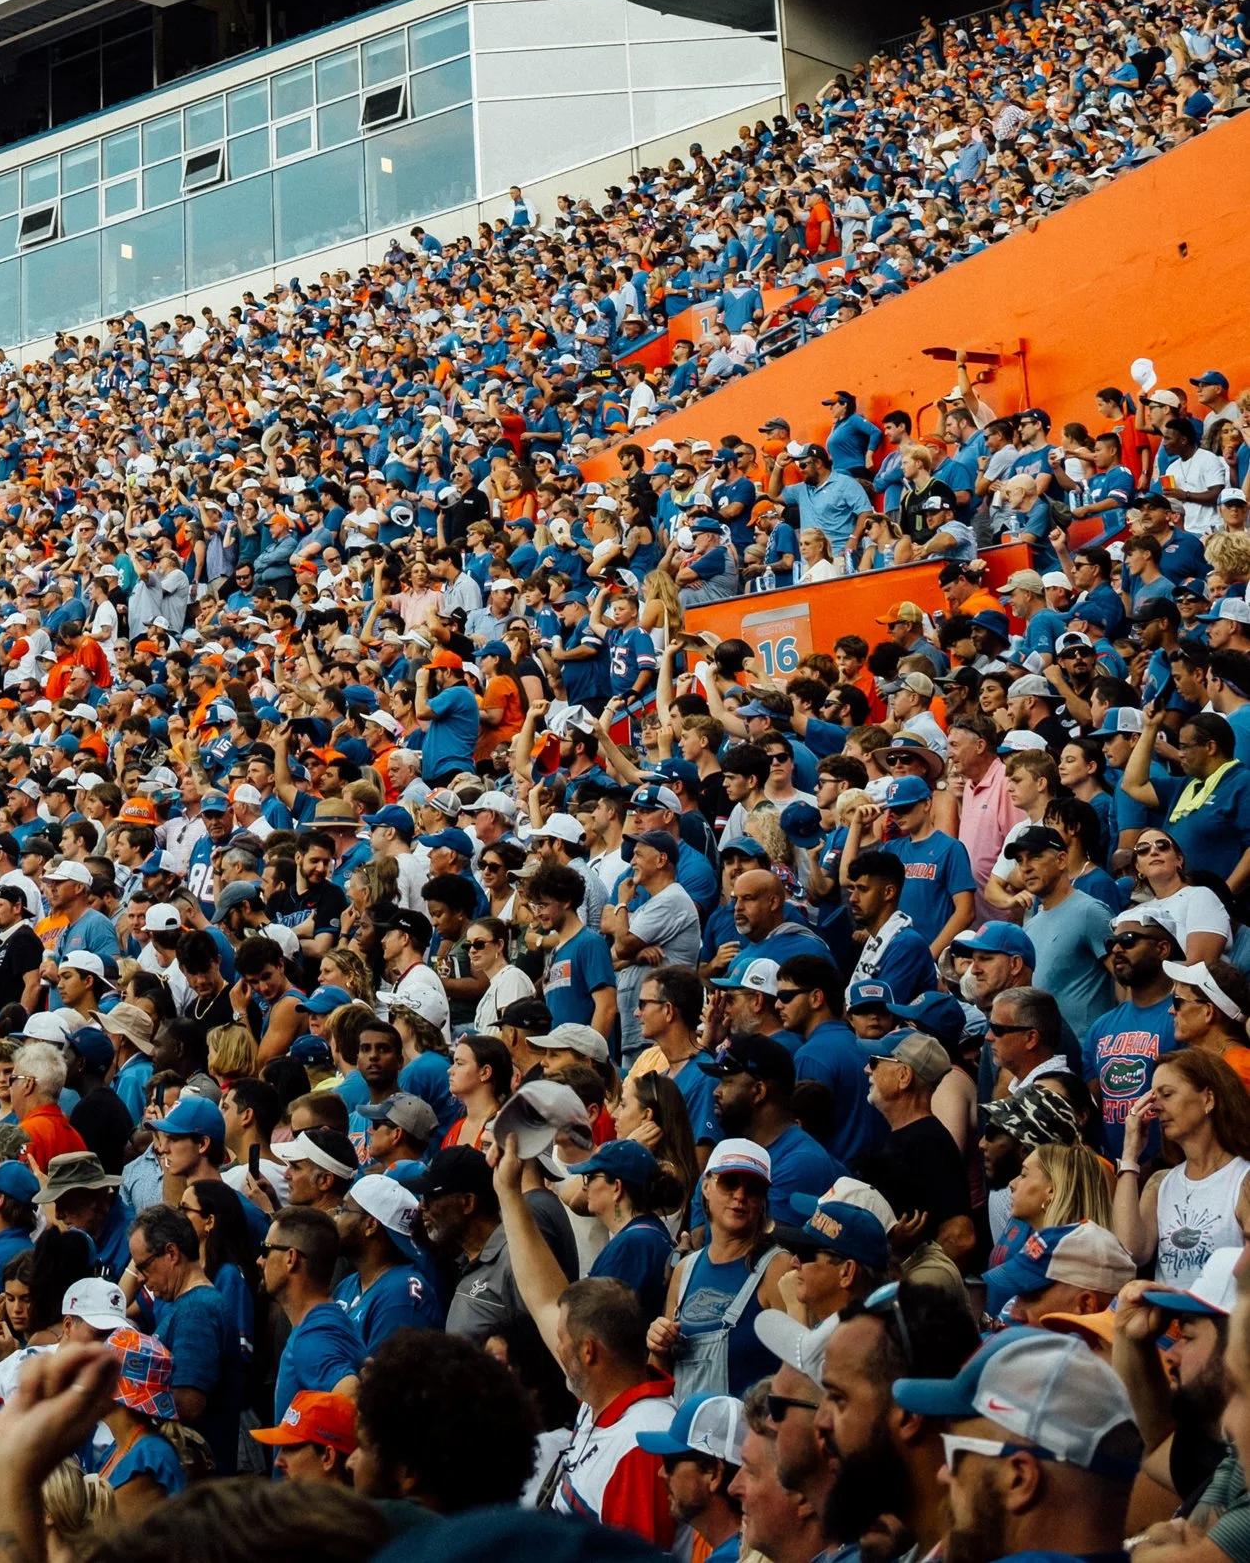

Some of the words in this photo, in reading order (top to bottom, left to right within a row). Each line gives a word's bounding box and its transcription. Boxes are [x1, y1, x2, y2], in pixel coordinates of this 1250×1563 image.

[591, 369, 613, 379] POLICE
[757, 636, 800, 677] 16
[886, 782, 900, 800] F
[1096, 1031, 1160, 1063] FLORIDA
[1160, 1245, 1212, 1278] Florid
[69, 1296, 79, 1310] F
